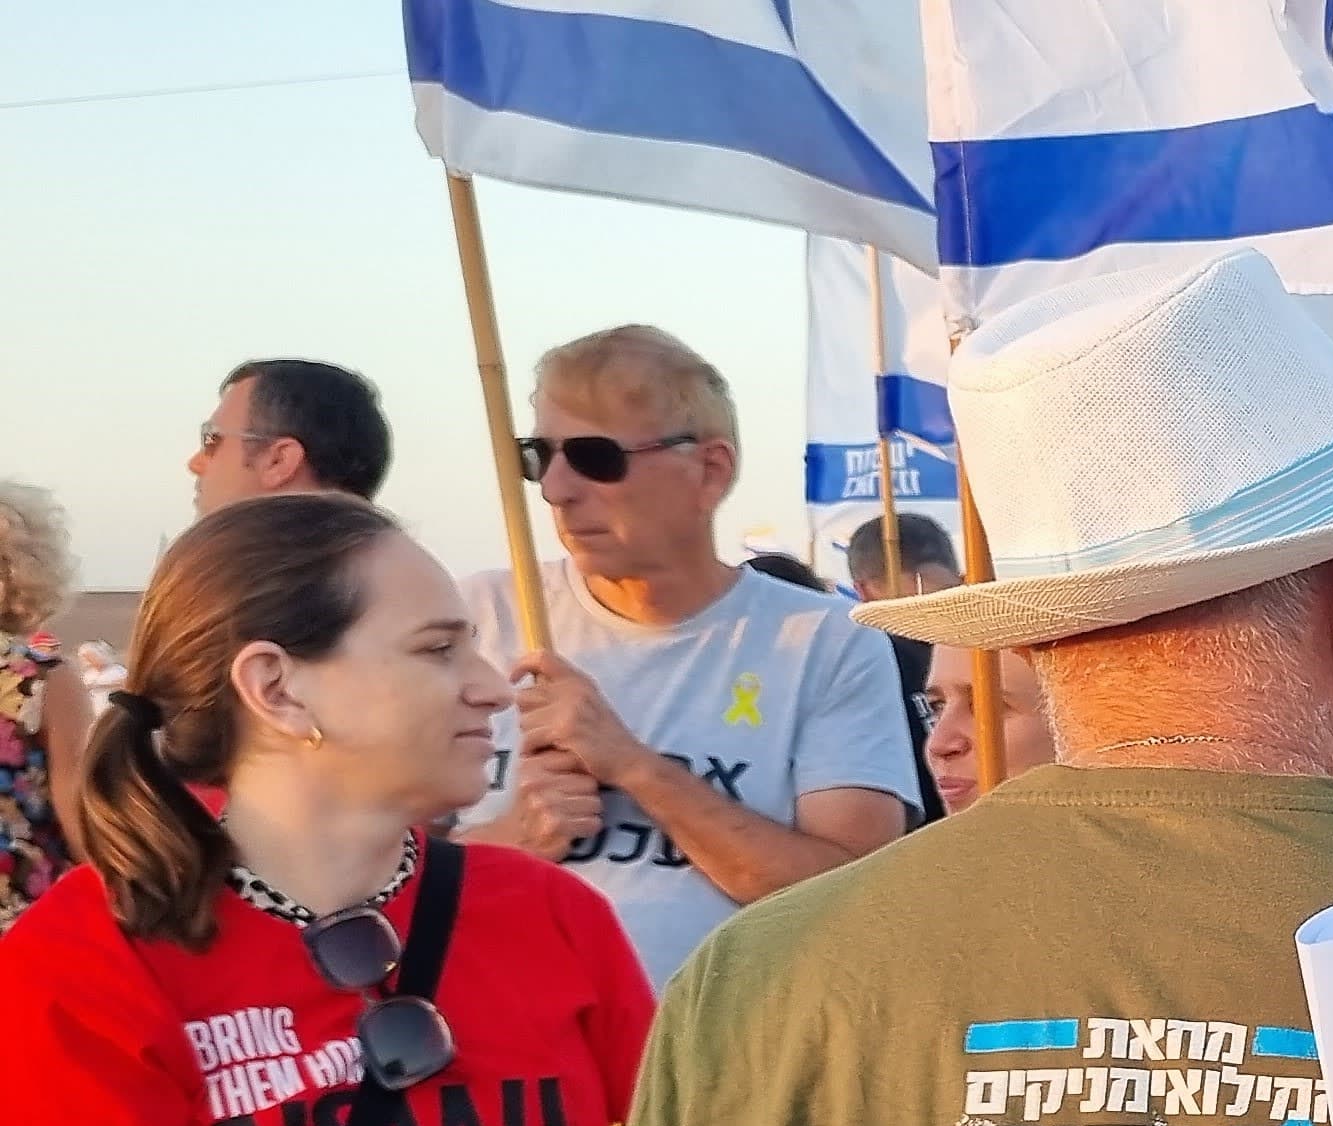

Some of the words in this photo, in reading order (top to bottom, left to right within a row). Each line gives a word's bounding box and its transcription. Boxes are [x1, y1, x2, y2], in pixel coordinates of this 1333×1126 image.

[184, 1007, 302, 1072] BRING
[1083, 1017, 1249, 1065] מחאת
[206, 1056, 306, 1119] THEM
[303, 1036, 366, 1089] HO
